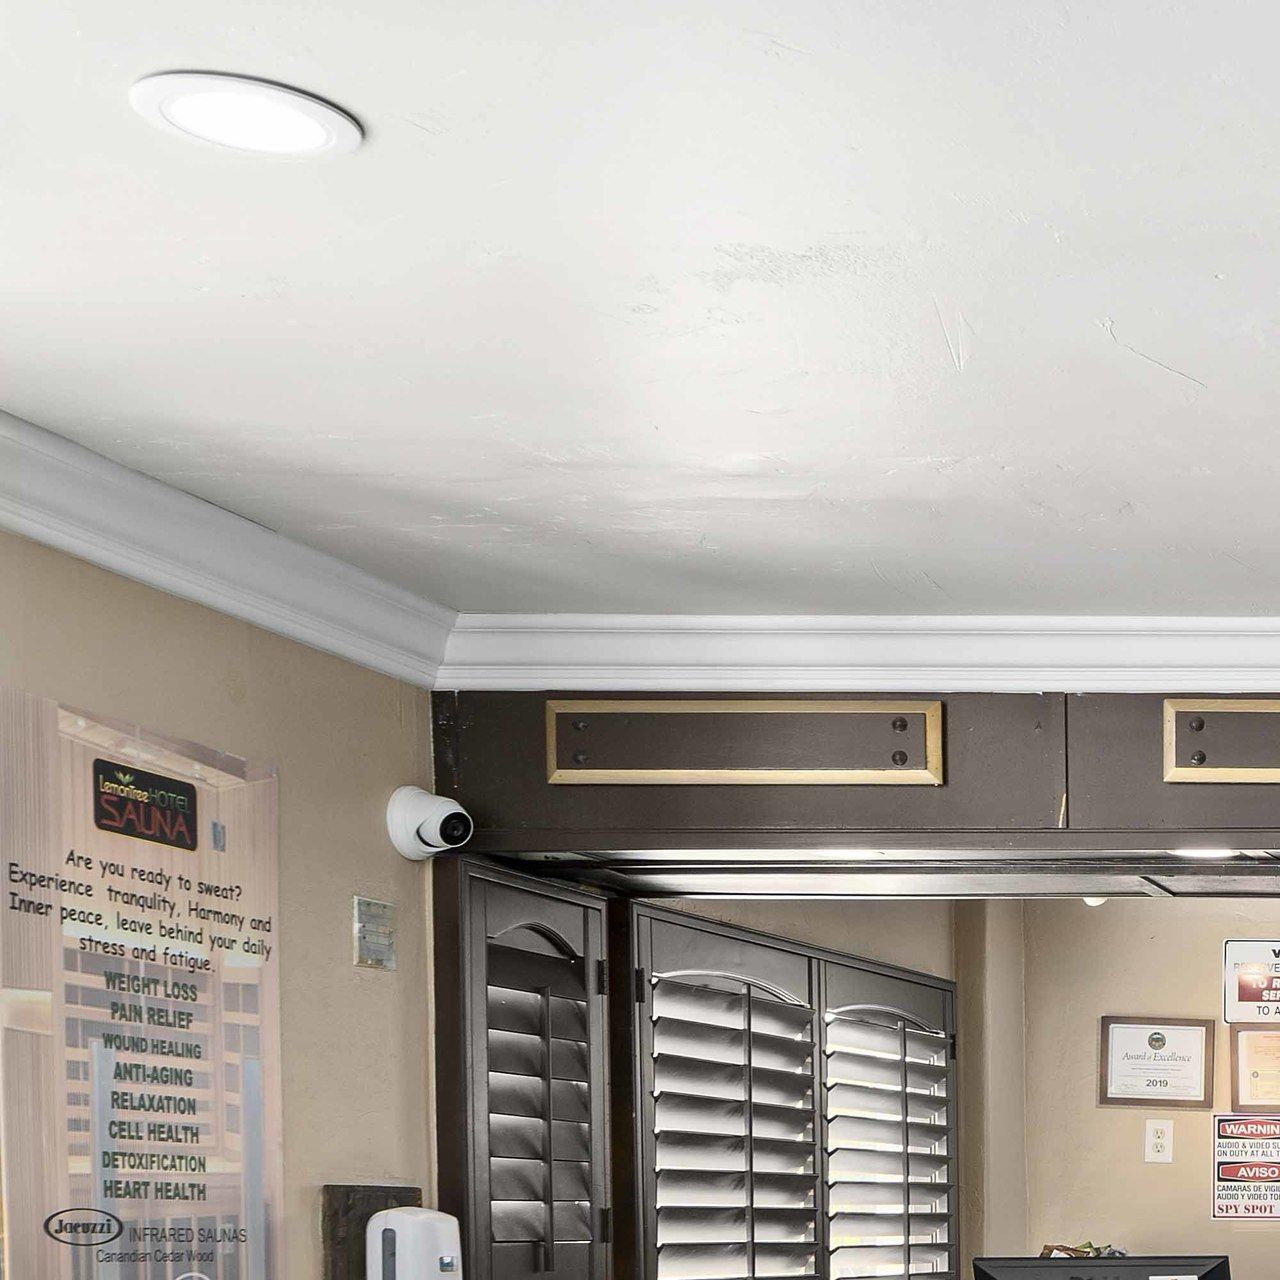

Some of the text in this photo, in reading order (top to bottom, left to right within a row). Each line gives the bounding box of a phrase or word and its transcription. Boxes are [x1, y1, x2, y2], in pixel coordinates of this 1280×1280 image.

[100, 795, 191, 844] SAUNA
[65, 849, 243, 901] Are you ready to sweat?
[8, 862, 272, 933] Experience tranqulity, Harmony and
[9, 892, 272, 962] Inner peace, leave behind your daily
[79, 936, 216, 974] stress and fatigue.
[103, 970, 198, 1002] WEIGHT LOSS
[110, 1001, 193, 1029] PAIN RELIEF
[1257, 1005, 1270, 1016] TO
[102, 1032, 202, 1059] WOUND HEALING
[1122, 1052, 1146, 1061] Award
[1153, 1052, 1191, 1062] Excellence
[113, 1061, 193, 1087] ANTI-AGING
[1146, 1079, 1168, 1087] 2019
[111, 1090, 196, 1115] RELAXATION
[109, 1120, 199, 1144] CELL HEALTH
[1217, 1141, 1239, 1149] AUDIO
[101, 1151, 206, 1173] DETOXIFICATION
[1237, 1167, 1279, 1178] AVISO
[103, 1180, 206, 1201] HEART HEALTH
[1246, 1193, 1268, 1201] VIDEO
[1217, 1204, 1275, 1214] SPY SPOT
[54, 1218, 247, 1243] Jacuzzi INFRARED SAUNAS
[154, 1250, 185, 1263] Cedar
[187, 1251, 214, 1263] Wood
